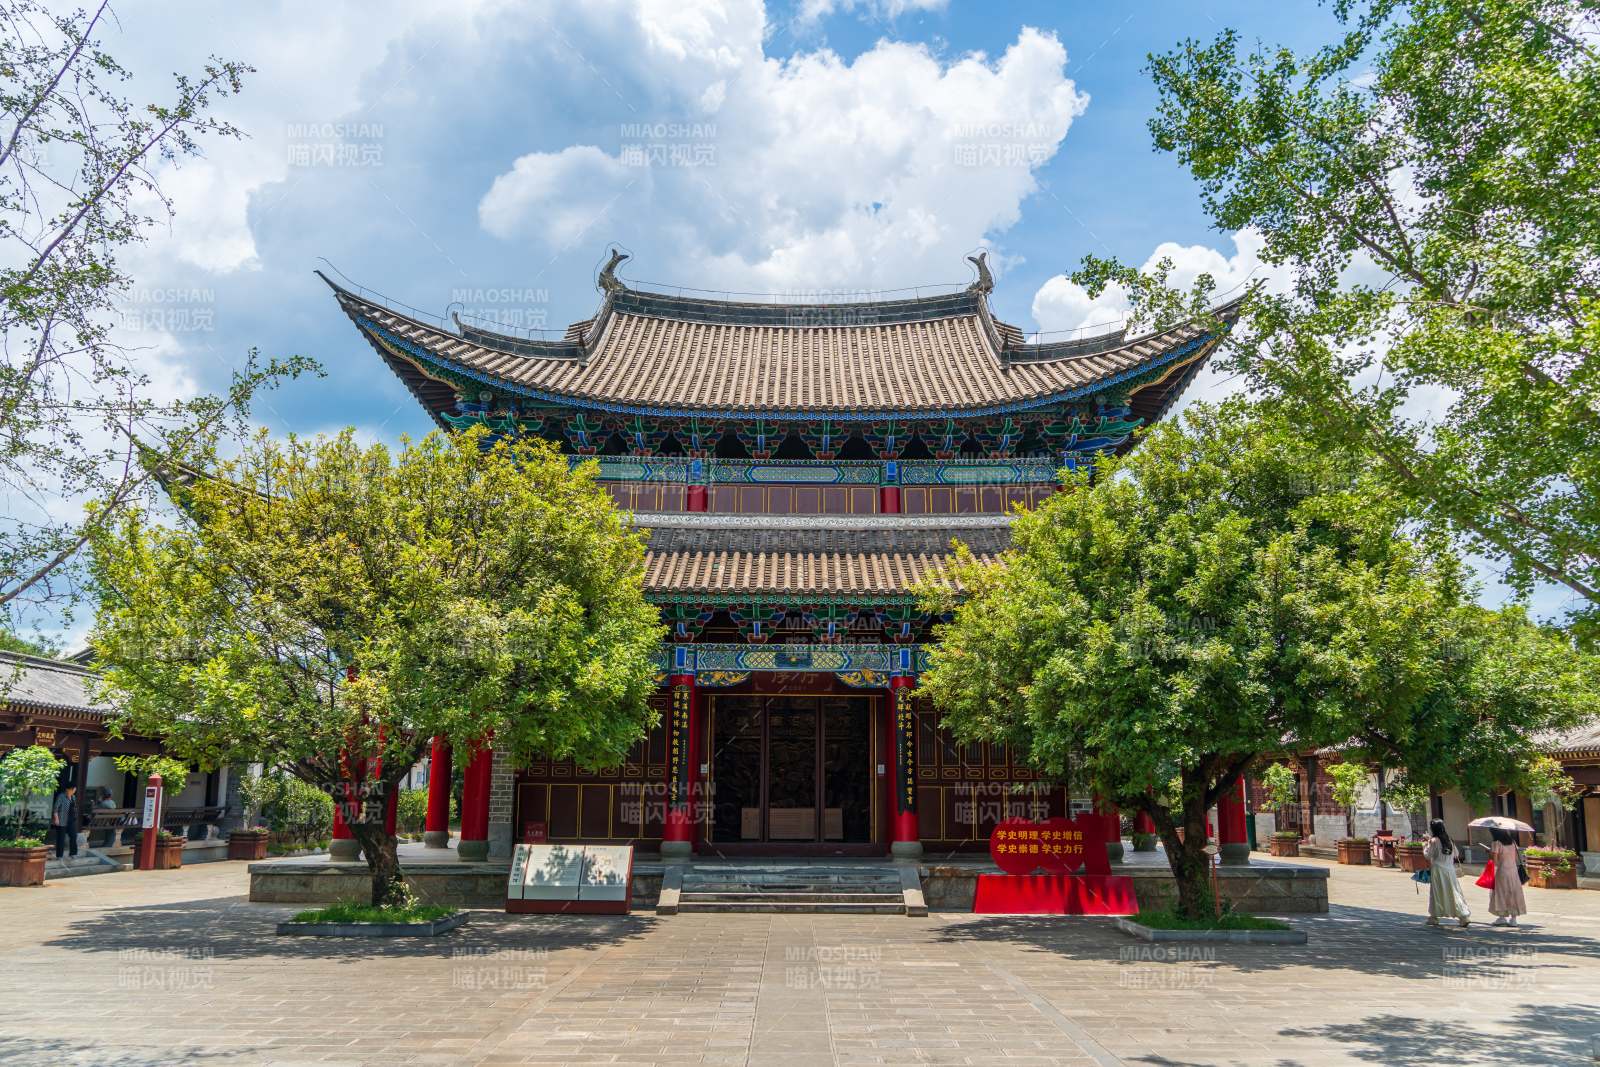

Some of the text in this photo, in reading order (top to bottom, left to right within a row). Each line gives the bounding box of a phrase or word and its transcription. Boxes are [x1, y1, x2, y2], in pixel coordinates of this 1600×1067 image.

[997, 830, 1083, 841] 学史明理 学史增信
[997, 844, 1084, 854] 学史崇德 学史力行
